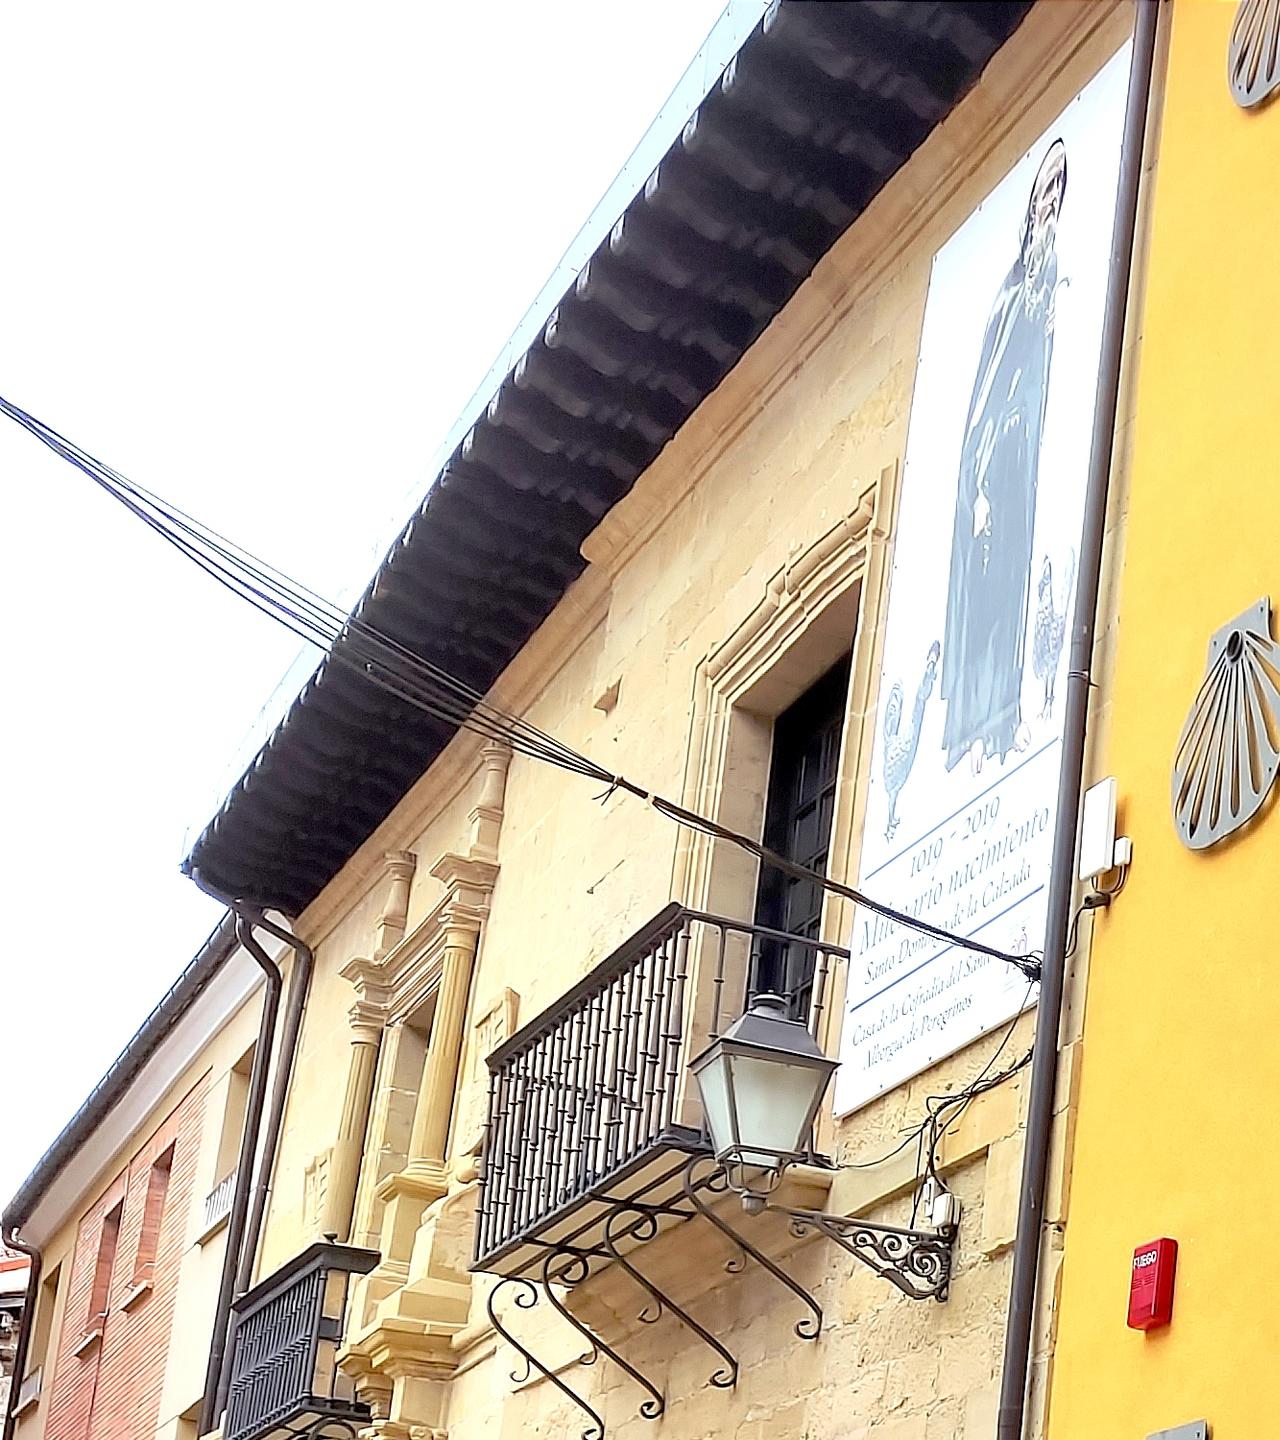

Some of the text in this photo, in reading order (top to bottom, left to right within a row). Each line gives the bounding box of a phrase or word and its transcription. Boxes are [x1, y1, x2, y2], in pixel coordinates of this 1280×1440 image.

[910, 837, 943, 878] 1019
[961, 796, 1000, 840] 2019
[859, 876, 943, 956] Mileario
[949, 807, 1049, 894] nacimiento
[864, 955, 896, 985] Santo
[982, 858, 1031, 908] Calzada
[853, 1020, 875, 1046] Casa
[945, 964, 962, 995] del
[864, 1039, 906, 1070] Albergue
[920, 993, 973, 1036] Peregrinos
[1133, 1250, 1158, 1270] FUEGO
